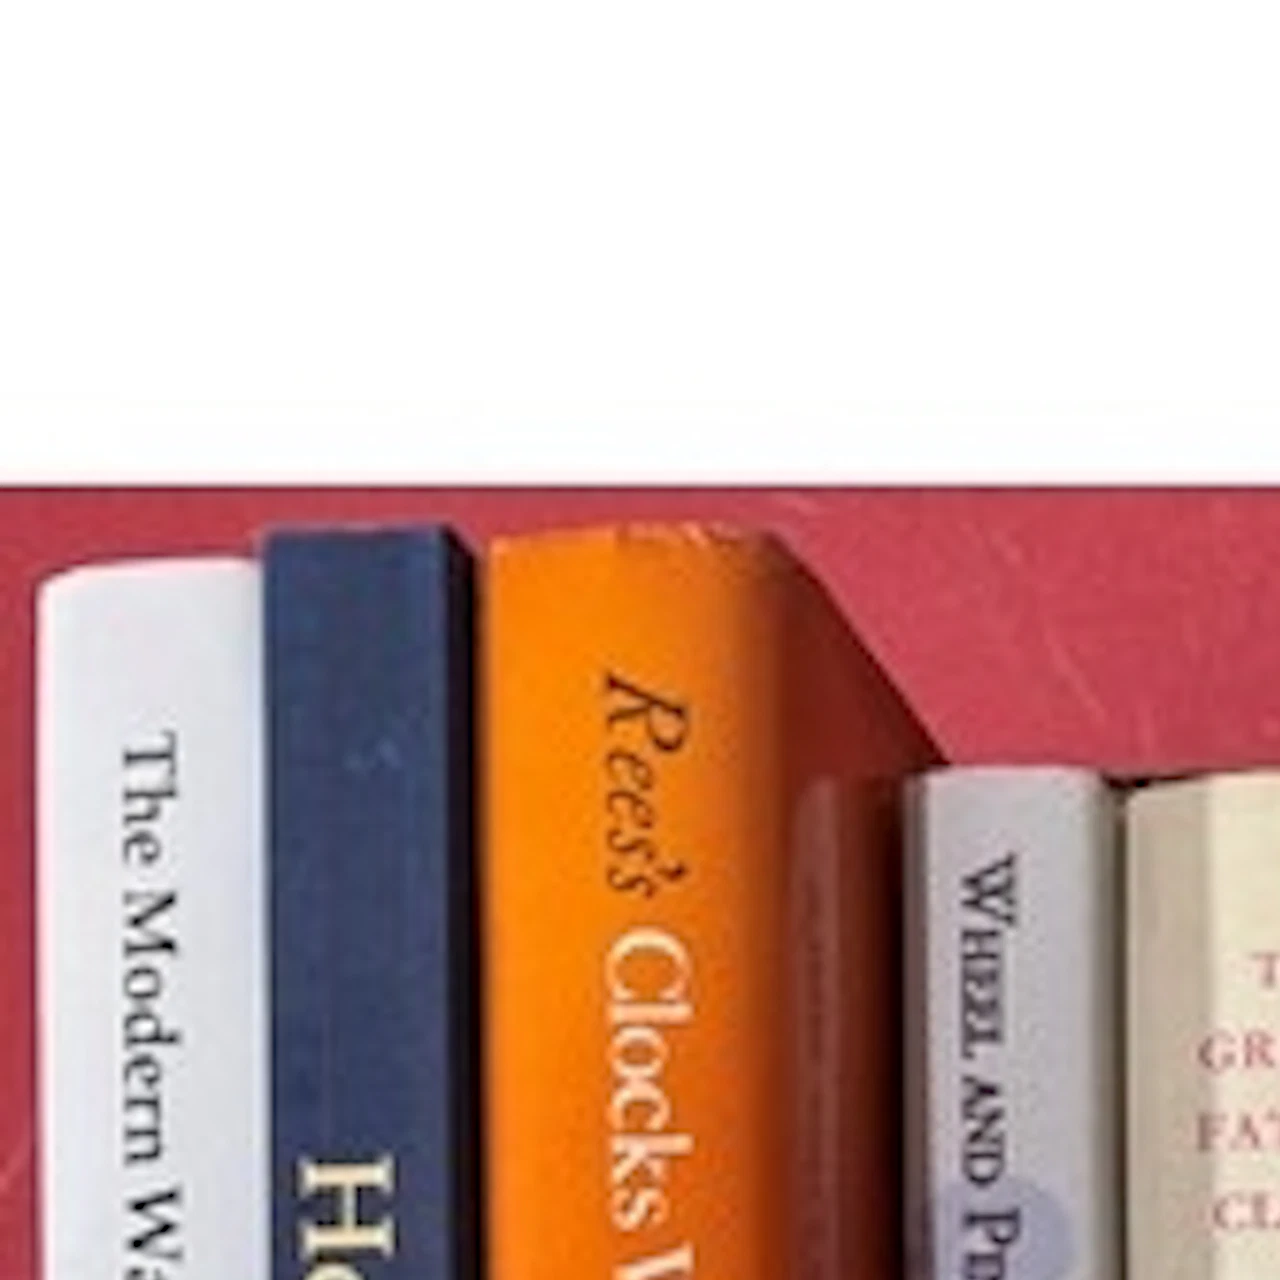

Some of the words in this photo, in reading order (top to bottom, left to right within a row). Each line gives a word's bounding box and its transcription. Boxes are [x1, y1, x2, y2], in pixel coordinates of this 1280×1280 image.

[121, 731, 177, 866] The
[606, 671, 689, 901] Rees's
[122, 890, 182, 1167] Modern
[606, 927, 695, 1232] Clocks
